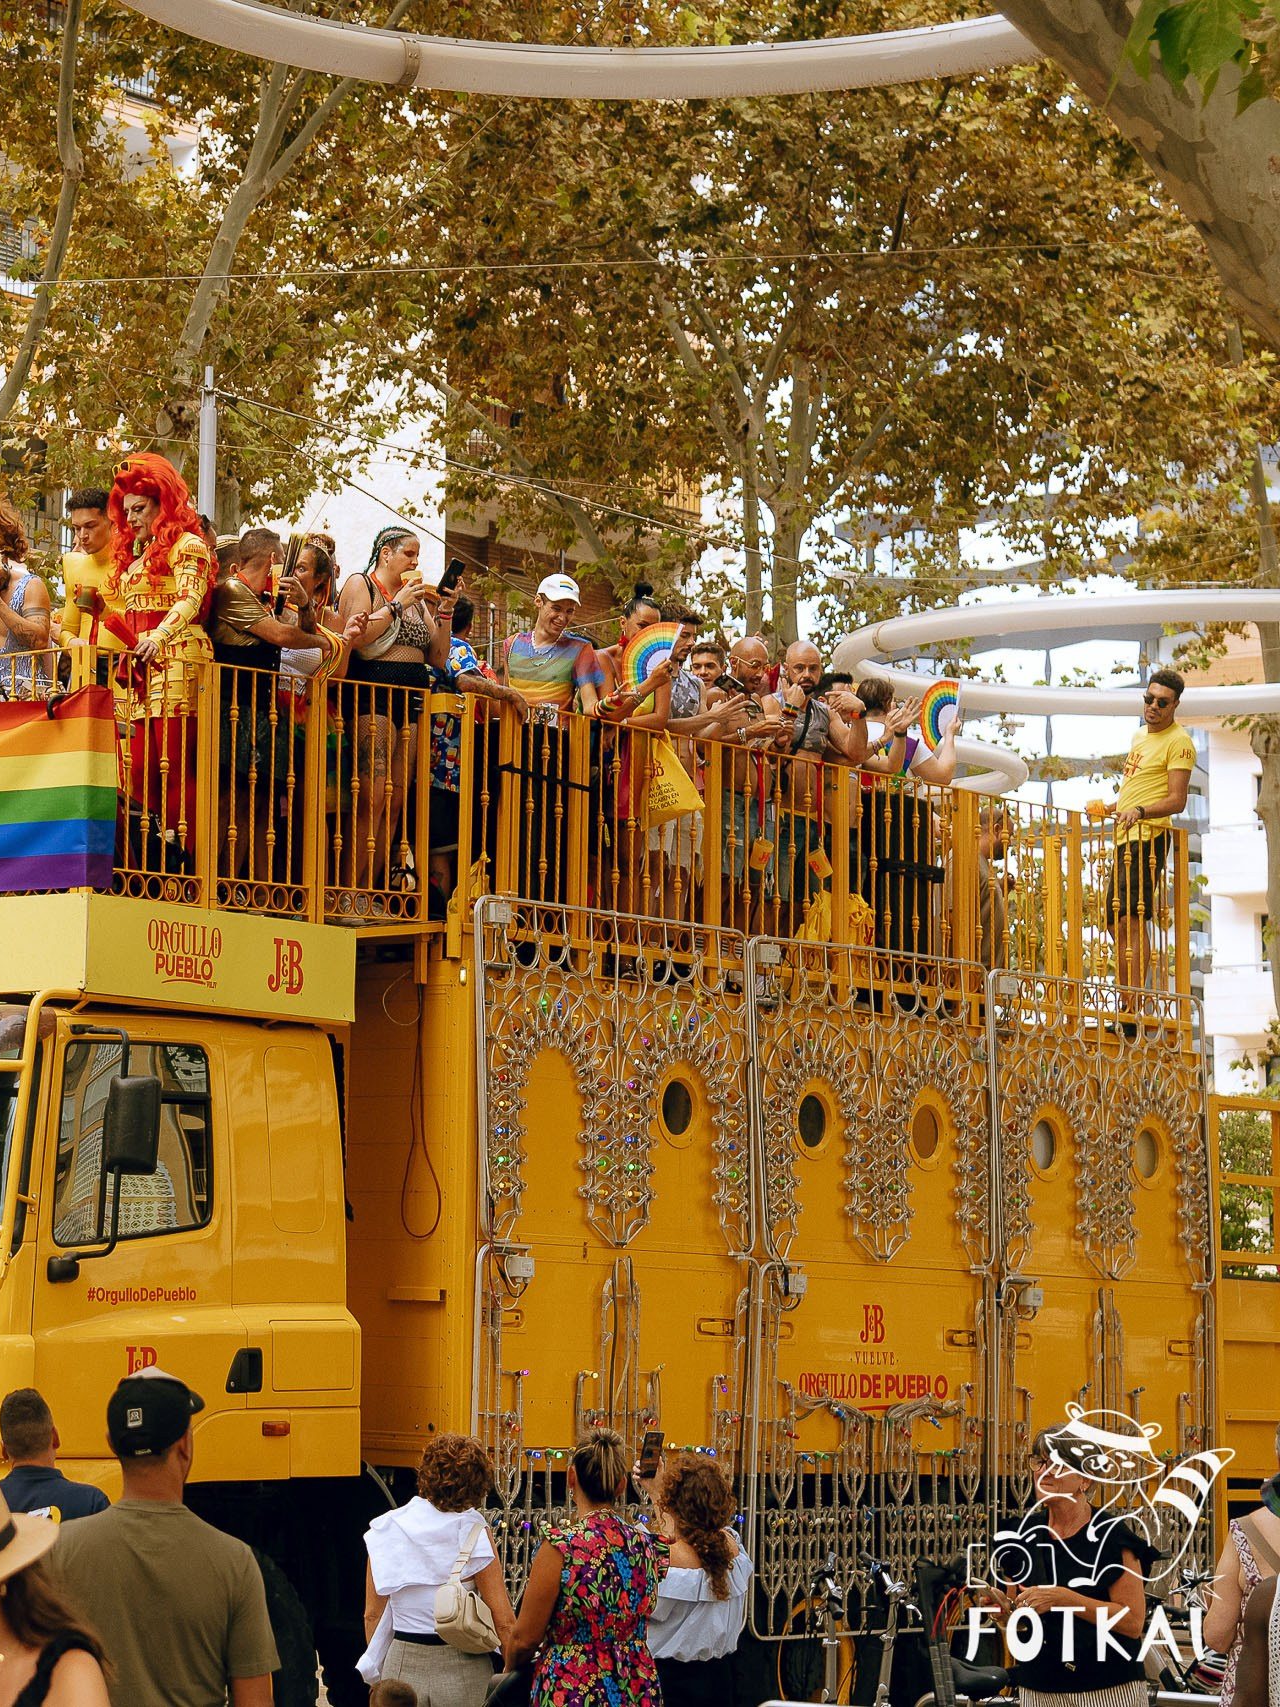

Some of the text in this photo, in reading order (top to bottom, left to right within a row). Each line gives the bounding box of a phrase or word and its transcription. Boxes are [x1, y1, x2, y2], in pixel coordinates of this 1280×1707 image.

[148, 919, 222, 958] ORGULLO
[155, 953, 214, 980] PUEBLO
[268, 937, 304, 995] J&B
[87, 1286, 197, 1306] #OrgulloDePueblo
[860, 1304, 885, 1343] J&B
[855, 1351, 895, 1365] VUELVE
[799, 1372, 949, 1399] ORGULLO DE PUEBLO
